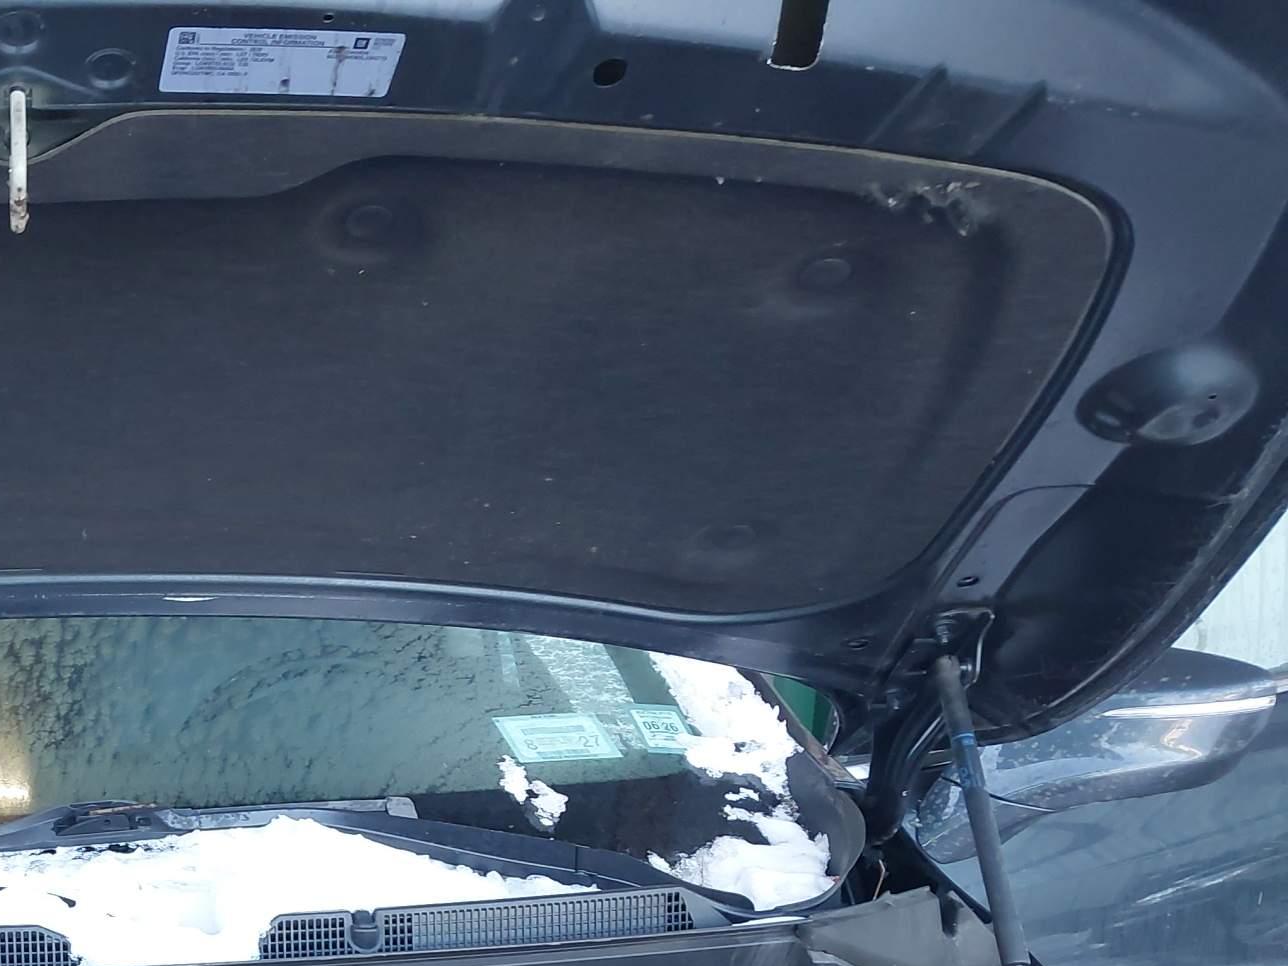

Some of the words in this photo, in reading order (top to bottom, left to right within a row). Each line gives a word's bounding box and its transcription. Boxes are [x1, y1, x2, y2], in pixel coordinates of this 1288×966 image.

[642, 720, 660, 730] 06
[661, 721, 679, 732] 26
[523, 739, 538, 750] 8
[578, 734, 600, 748] 27
